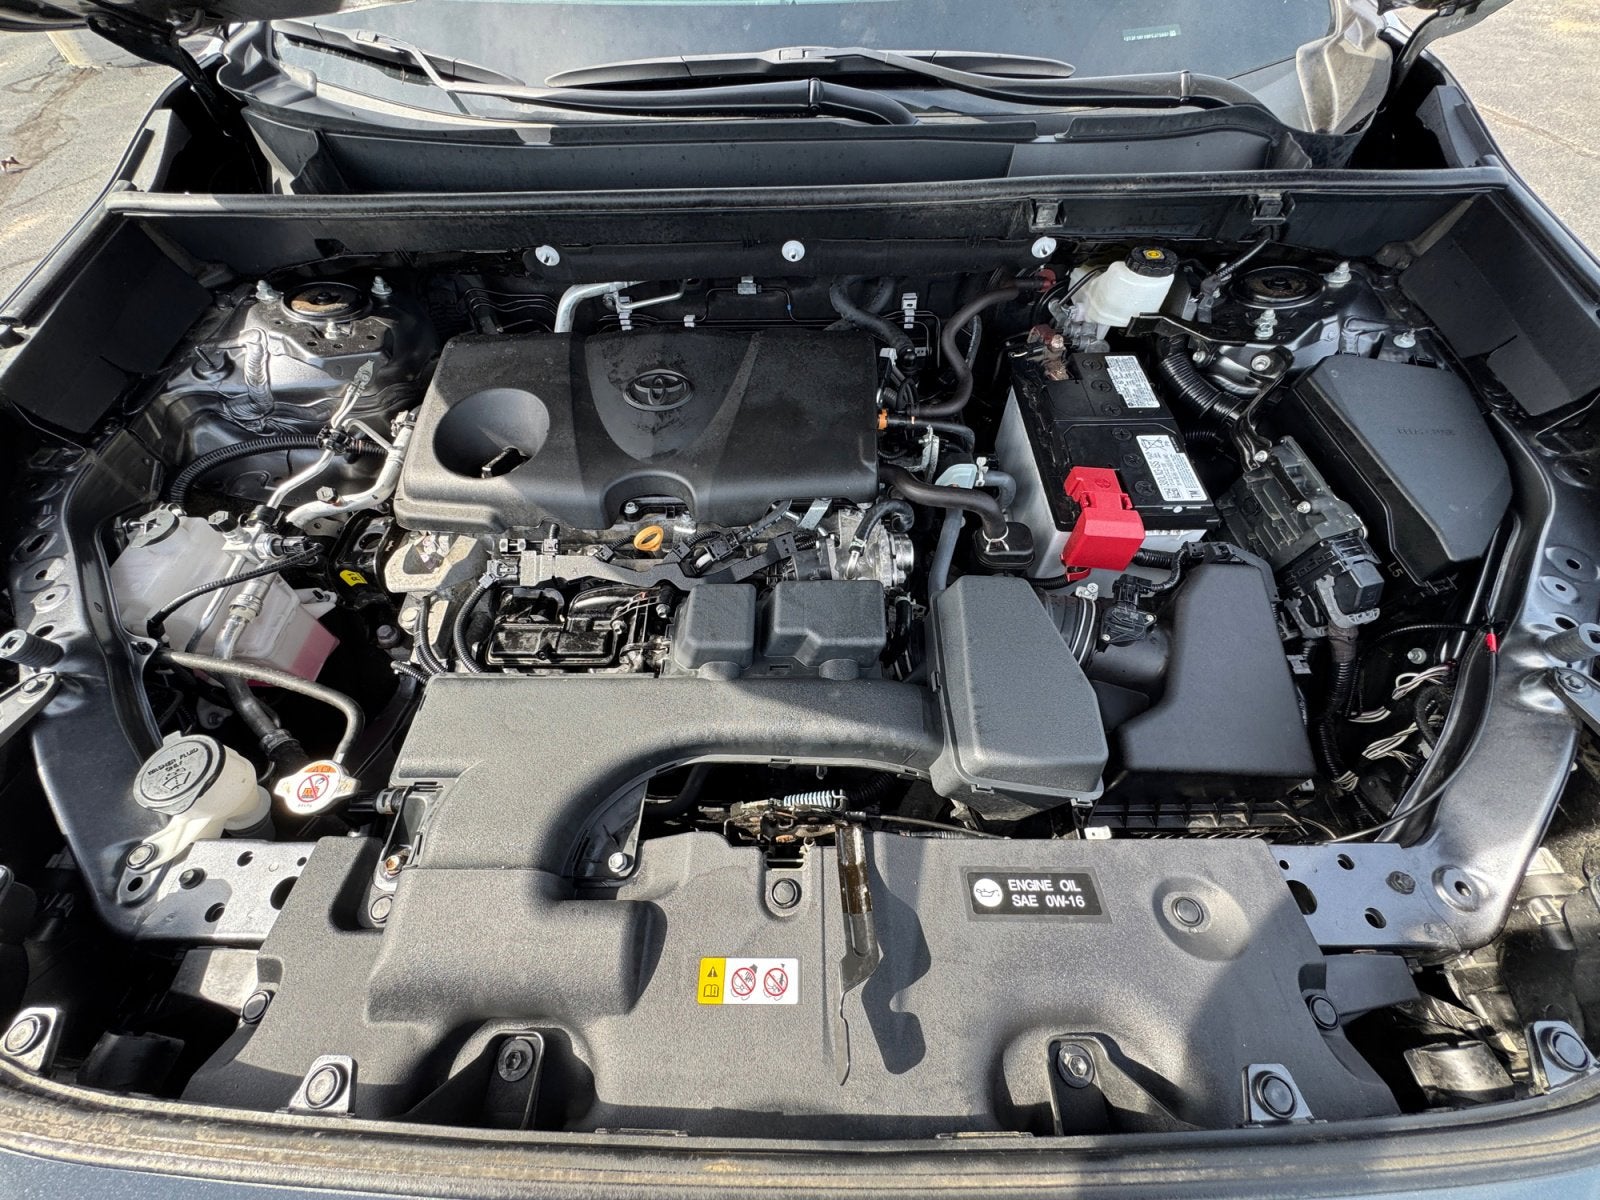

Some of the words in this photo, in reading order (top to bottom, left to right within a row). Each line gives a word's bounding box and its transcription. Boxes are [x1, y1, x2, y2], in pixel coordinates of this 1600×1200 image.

[147, 758, 177, 776] WASHER
[179, 747, 199, 760] FLUID
[1007, 879, 1053, 892] ENGINE
[1059, 879, 1082, 892] OIL
[1011, 894, 1039, 907] SAE
[1045, 895, 1085, 908] 0W-16
